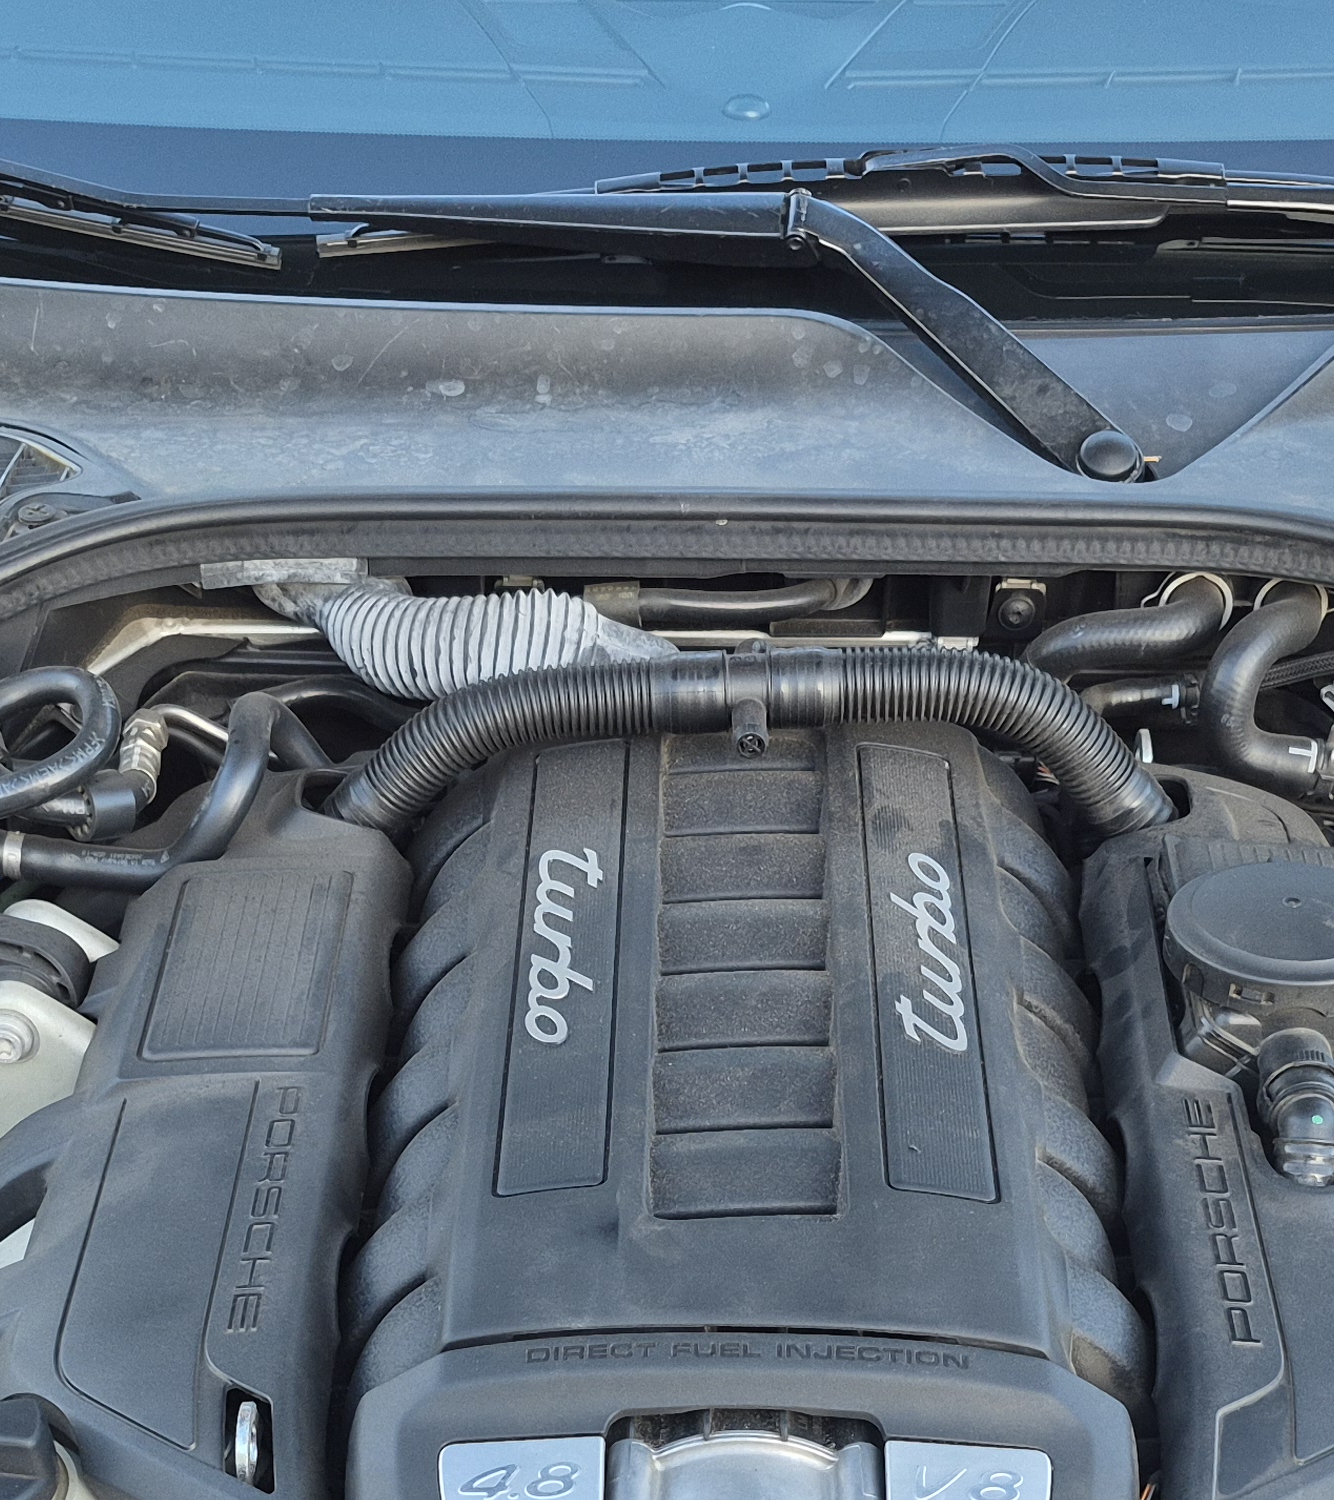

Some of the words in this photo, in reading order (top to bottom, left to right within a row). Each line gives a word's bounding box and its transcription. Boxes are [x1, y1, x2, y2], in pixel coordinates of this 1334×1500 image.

[524, 847, 603, 1045] turbo
[890, 852, 968, 1054] turbo
[226, 1086, 302, 1332] PORSCHE
[1184, 1099, 1263, 1345] PORSCHE
[525, 1342, 657, 1364] DIRECT
[671, 1343, 762, 1358] FUEL
[776, 1344, 971, 1370] INJECTION
[458, 1461, 580, 1500] 4.8
